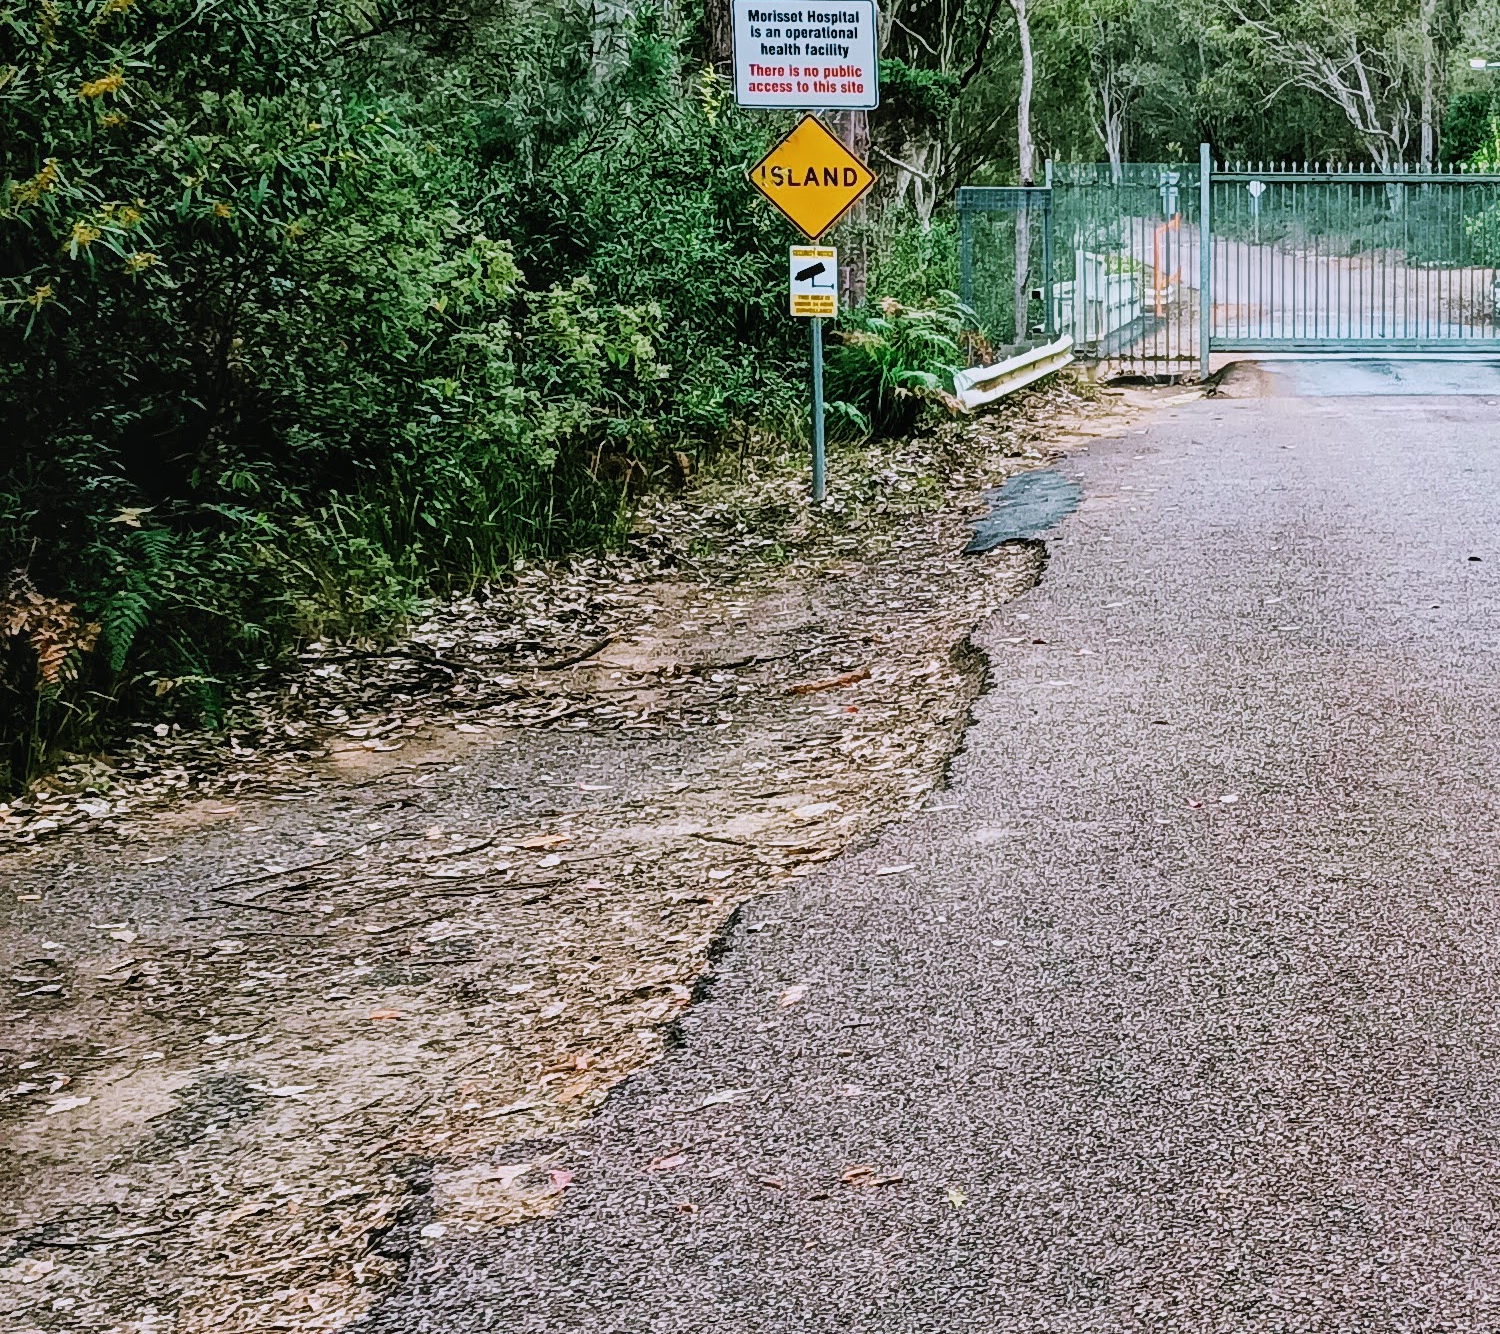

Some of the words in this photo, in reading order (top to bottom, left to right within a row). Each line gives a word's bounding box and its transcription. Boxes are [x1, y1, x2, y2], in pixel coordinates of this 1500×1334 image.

[748, 9, 803, 23] Morisset
[807, 10, 860, 26] Hospital
[750, 25, 762, 38] is
[765, 28, 781, 38] an
[785, 26, 858, 41] operational
[760, 43, 801, 56] health
[805, 43, 850, 59] facility
[748, 63, 785, 77] There
[789, 64, 800, 77] is
[803, 67, 819, 78] no
[823, 64, 863, 79] public
[748, 82, 793, 93] access
[796, 80, 809, 93] to
[813, 80, 837, 94] this
[840, 81, 864, 94] site
[761, 165, 858, 187] ISLAND
